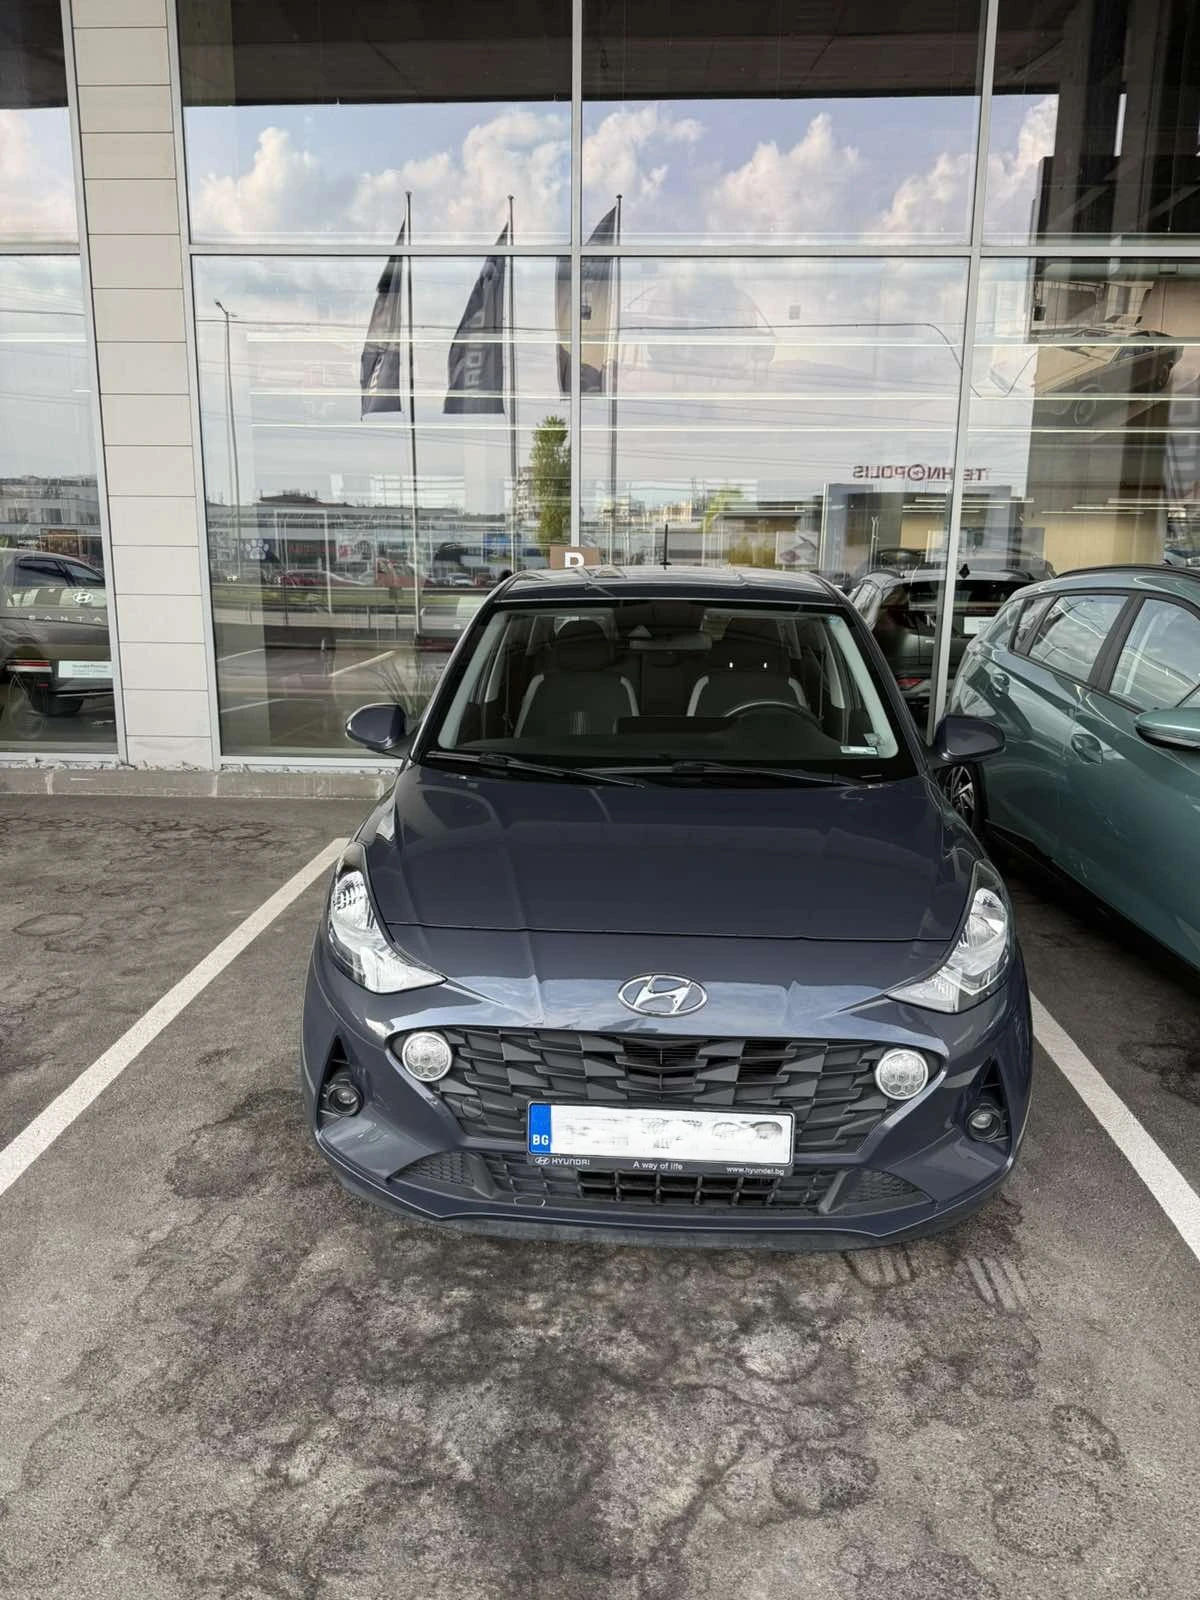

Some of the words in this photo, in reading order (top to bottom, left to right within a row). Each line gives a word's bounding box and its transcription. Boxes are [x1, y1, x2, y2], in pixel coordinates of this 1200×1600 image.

[532, 1134, 549, 1146] BG
[551, 1157, 590, 1166] HYUNDAI
[633, 1160, 640, 1169] A
[641, 1162, 657, 1171] way
[659, 1162, 669, 1170] of
[670, 1162, 683, 1171] life
